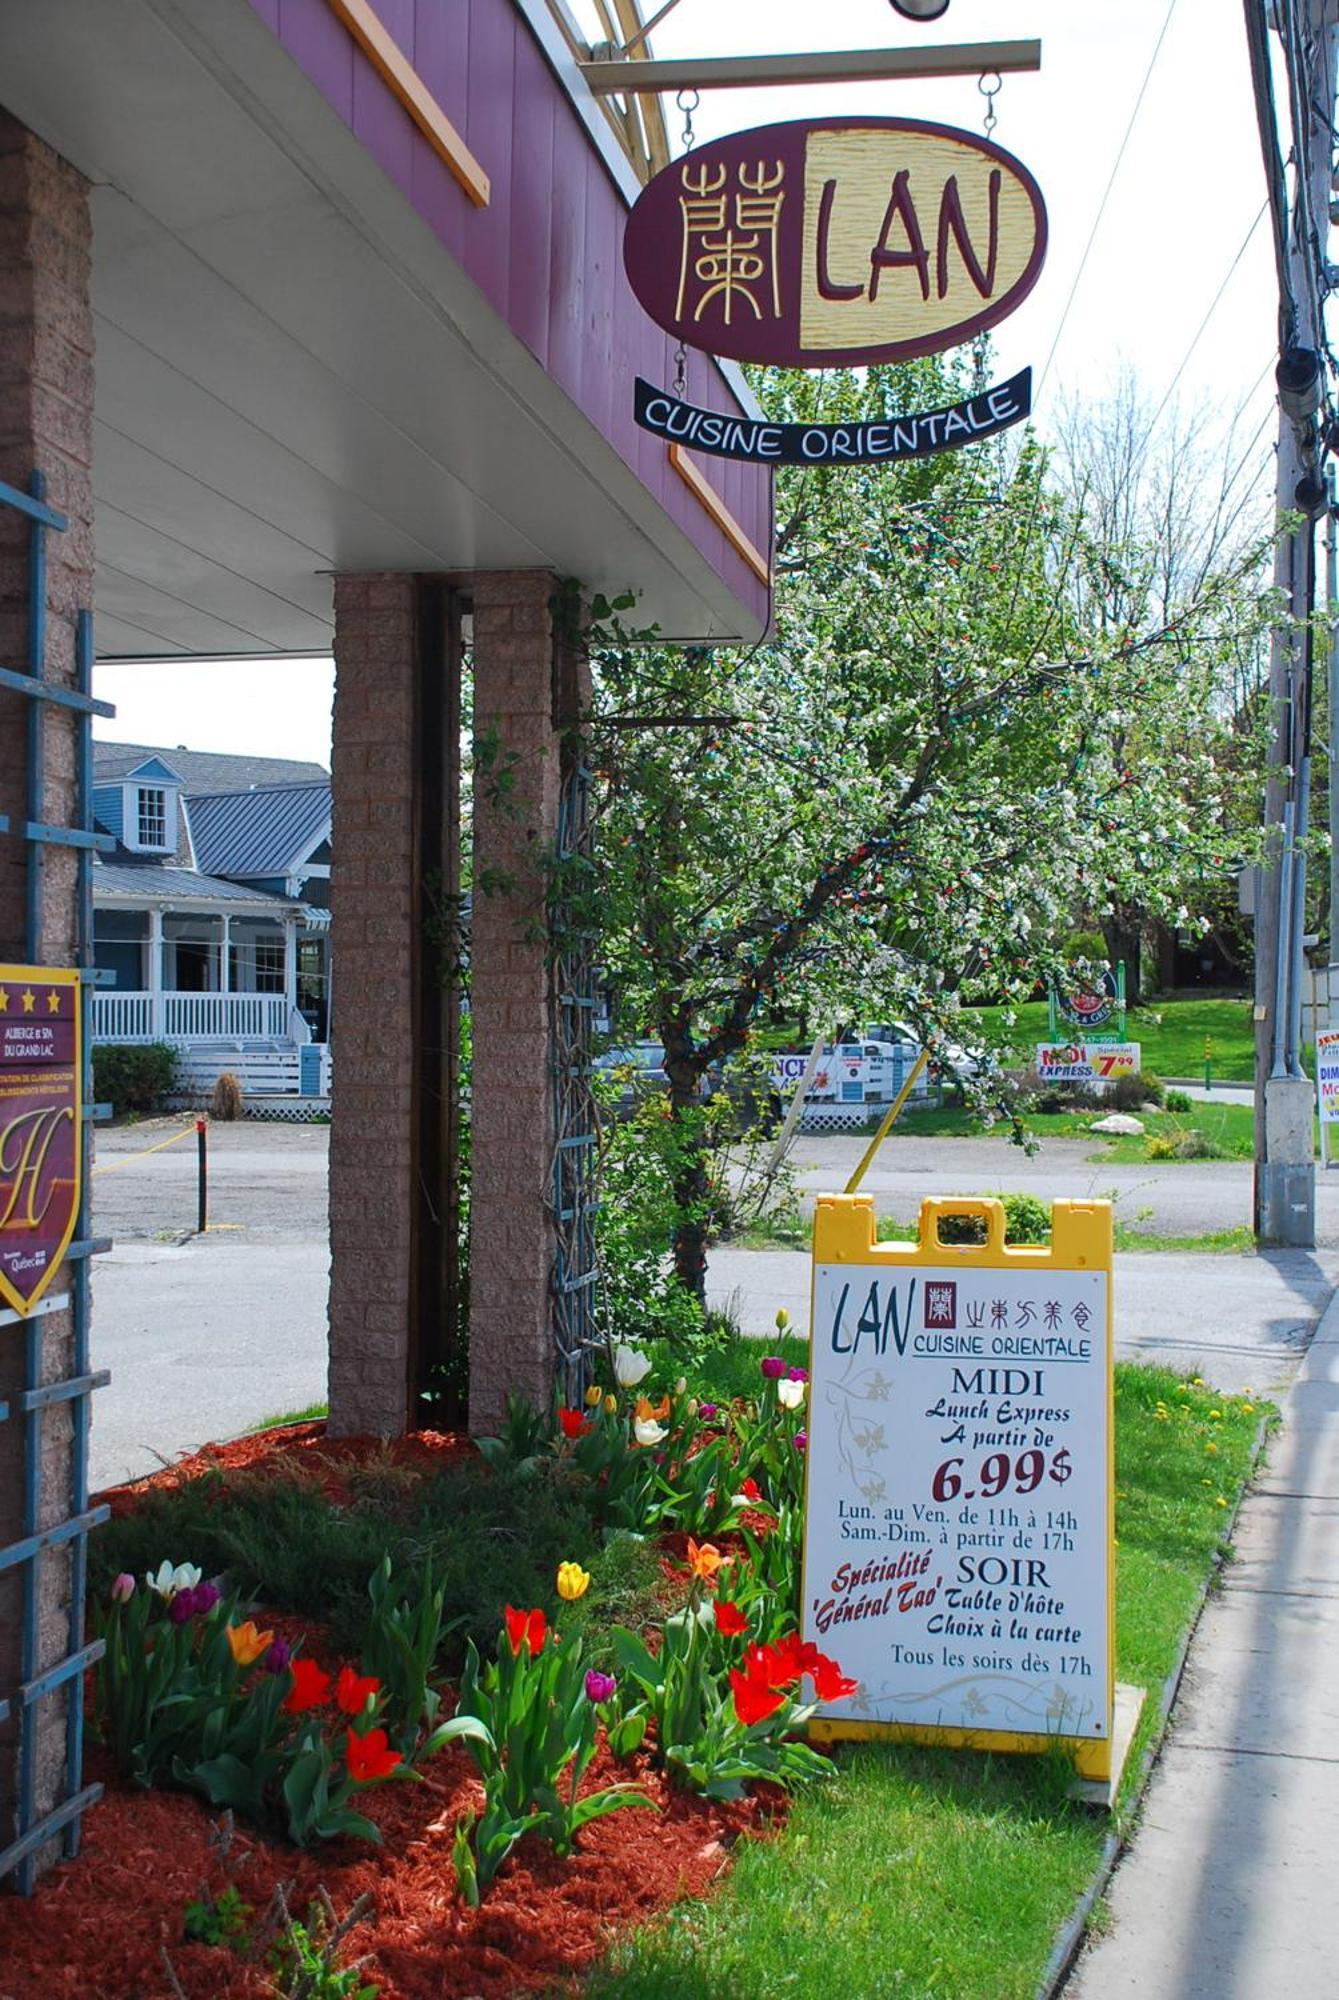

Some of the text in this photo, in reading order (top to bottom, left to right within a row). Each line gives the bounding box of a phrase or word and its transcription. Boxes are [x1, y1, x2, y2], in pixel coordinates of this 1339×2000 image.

[817, 169, 1001, 302] LAN
[645, 387, 1020, 459] CUISINE ORIENTALE
[4, 1043, 54, 1057] DU GRAND LAC
[1039, 1065, 1093, 1077] EXPRESS
[831, 1277, 915, 1356] LAN
[913, 1334, 1092, 1358] CUISINE ORIENTALE
[951, 1367, 1045, 1397] MIDI
[925, 1398, 1071, 1425] Lunch Express
[940, 1419, 1054, 1449] À partir de
[932, 1446, 1073, 1503] 6.99$
[838, 1500, 1078, 1531] Lun. au Ven. de 11h à 14h
[840, 1521, 1074, 1552] Sam.-Dim. à partir de 17h
[831, 1549, 934, 1593] Spécialité
[956, 1555, 1051, 1588] SOIR
[944, 1588, 1064, 1616] Table d'hôte
[926, 1614, 1081, 1643] Choix à la carte
[891, 1644, 1092, 1676] Tous les soirs dès 17h
